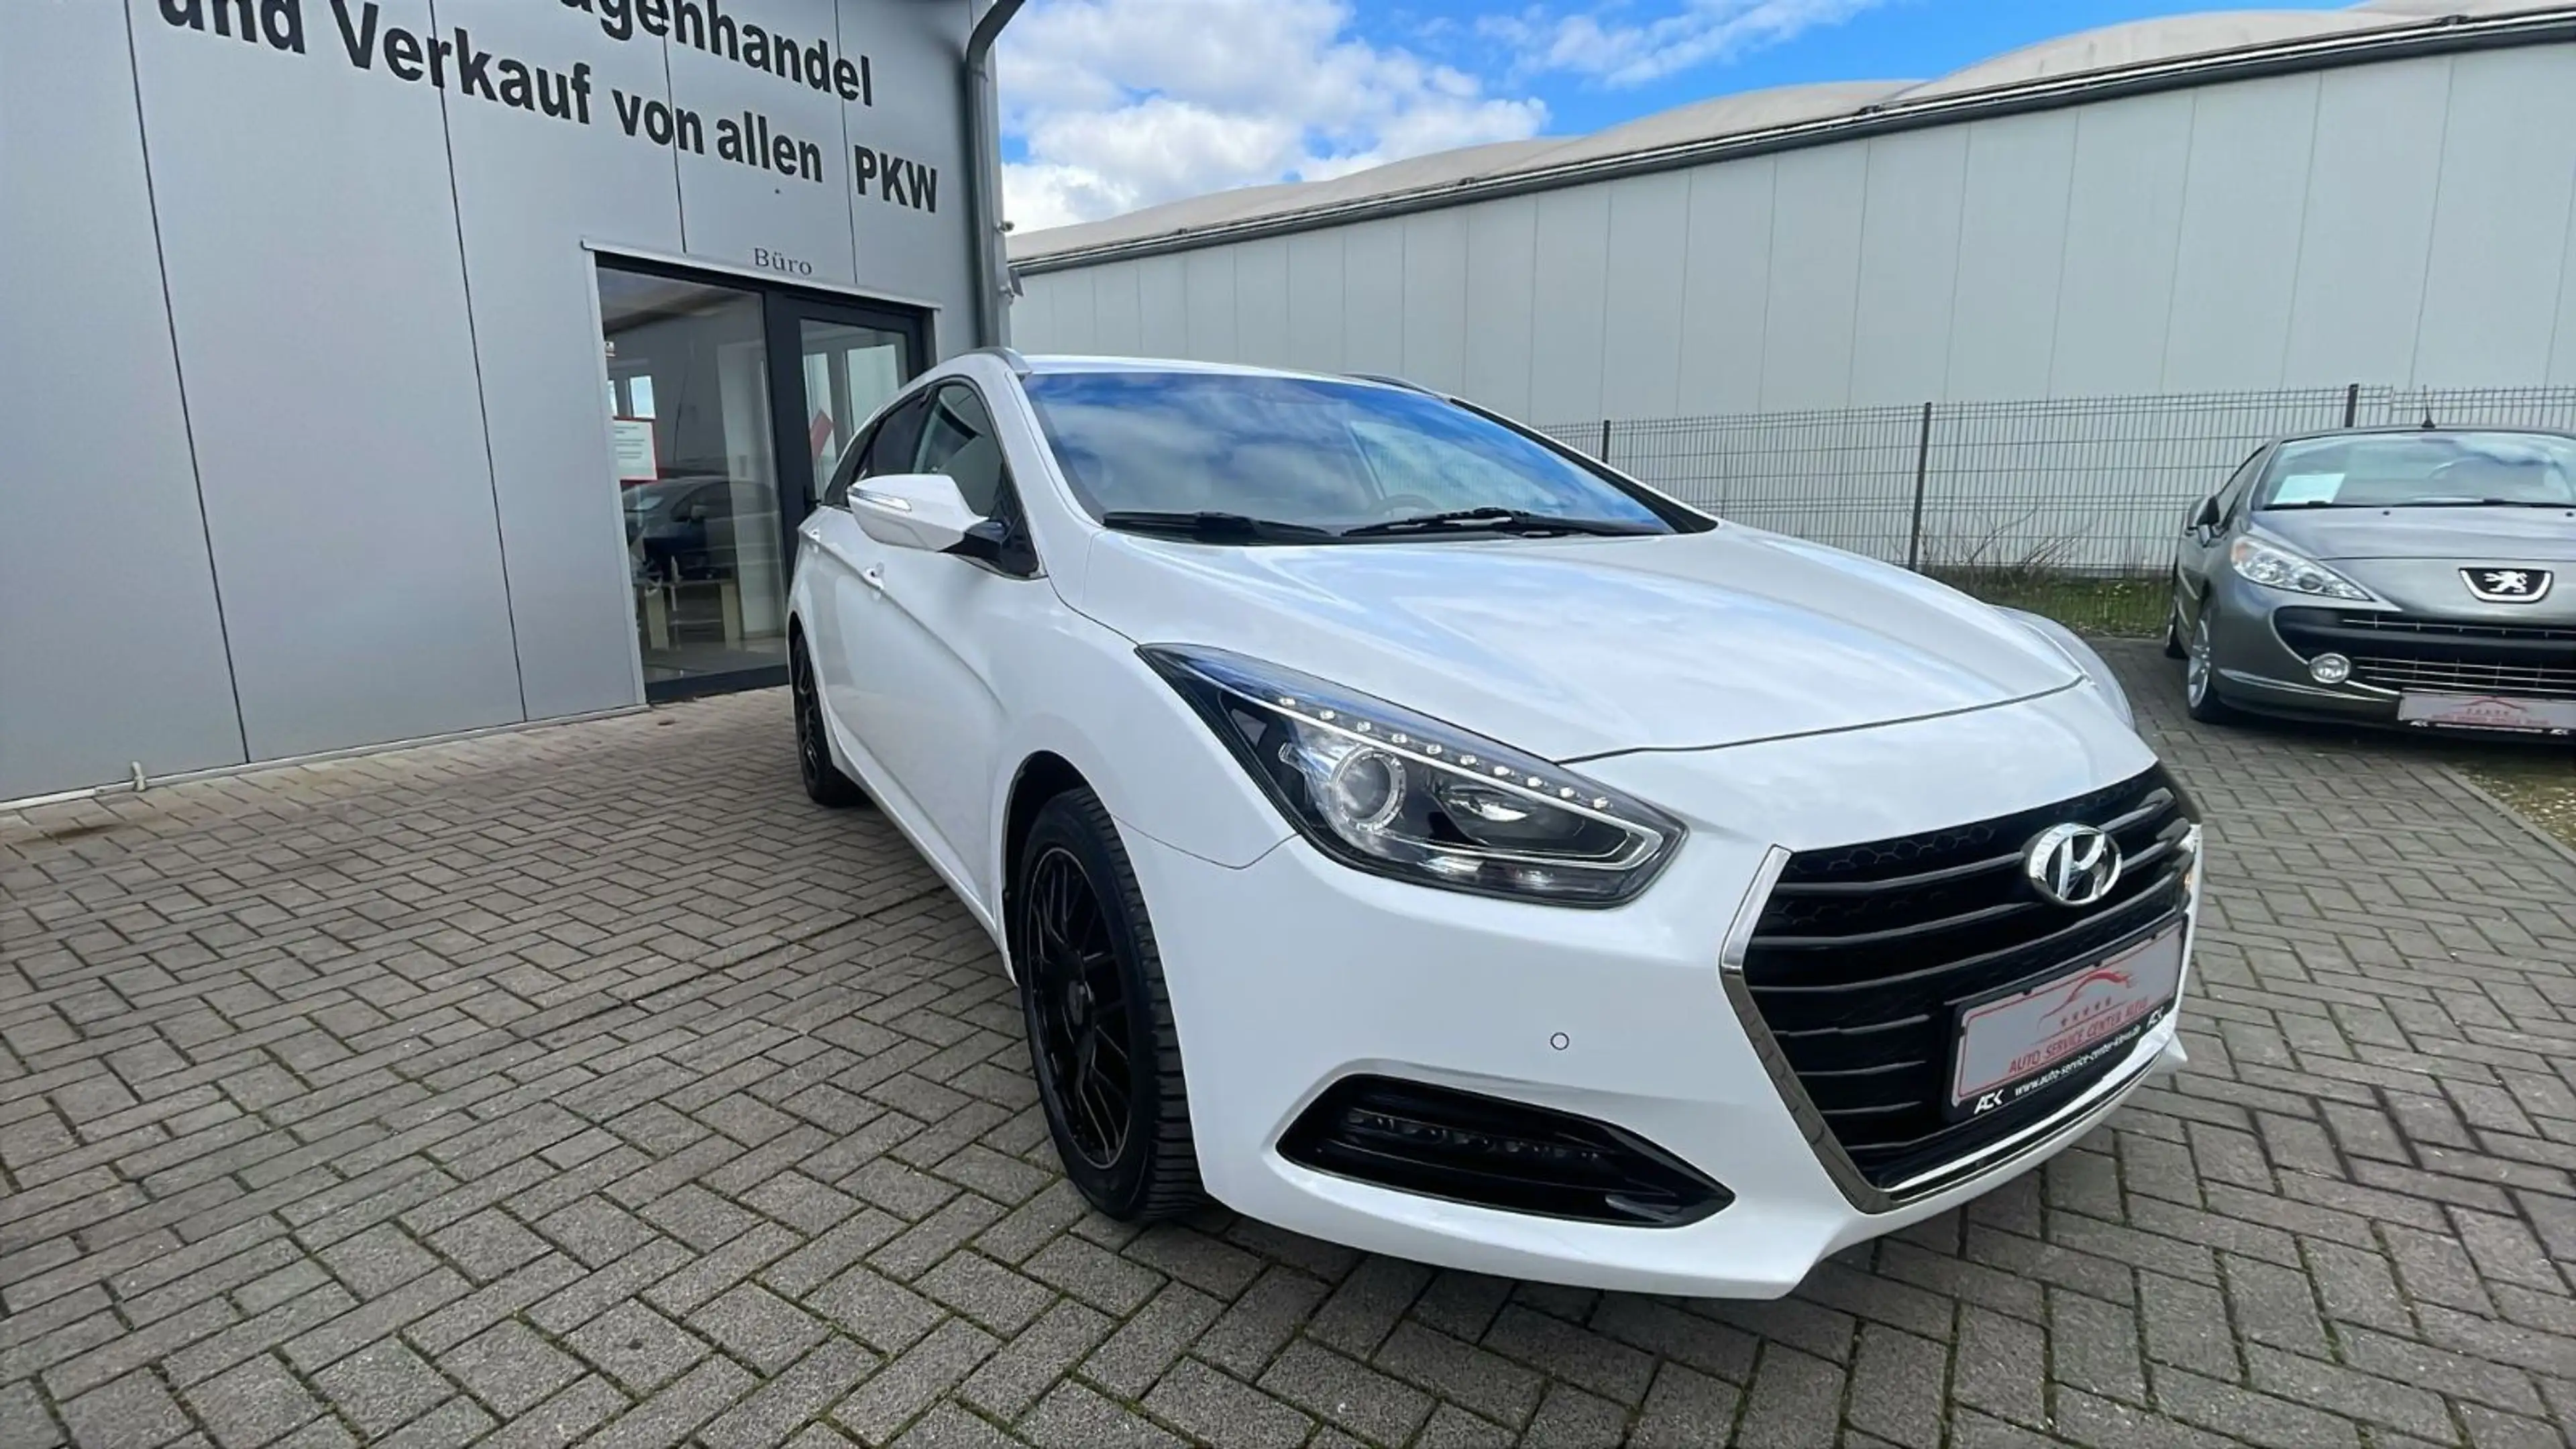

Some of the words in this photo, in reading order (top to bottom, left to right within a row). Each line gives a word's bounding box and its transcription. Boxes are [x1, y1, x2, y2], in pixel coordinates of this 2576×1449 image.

[329, 0, 592, 125] Verkauf
[611, 89, 704, 156] von
[716, 110, 823, 184] allen
[854, 144, 938, 213] PKW
[755, 247, 812, 276] Büro
[2008, 1049, 2041, 1074] AUTO
[2046, 1026, 2085, 1057] SERVICE
